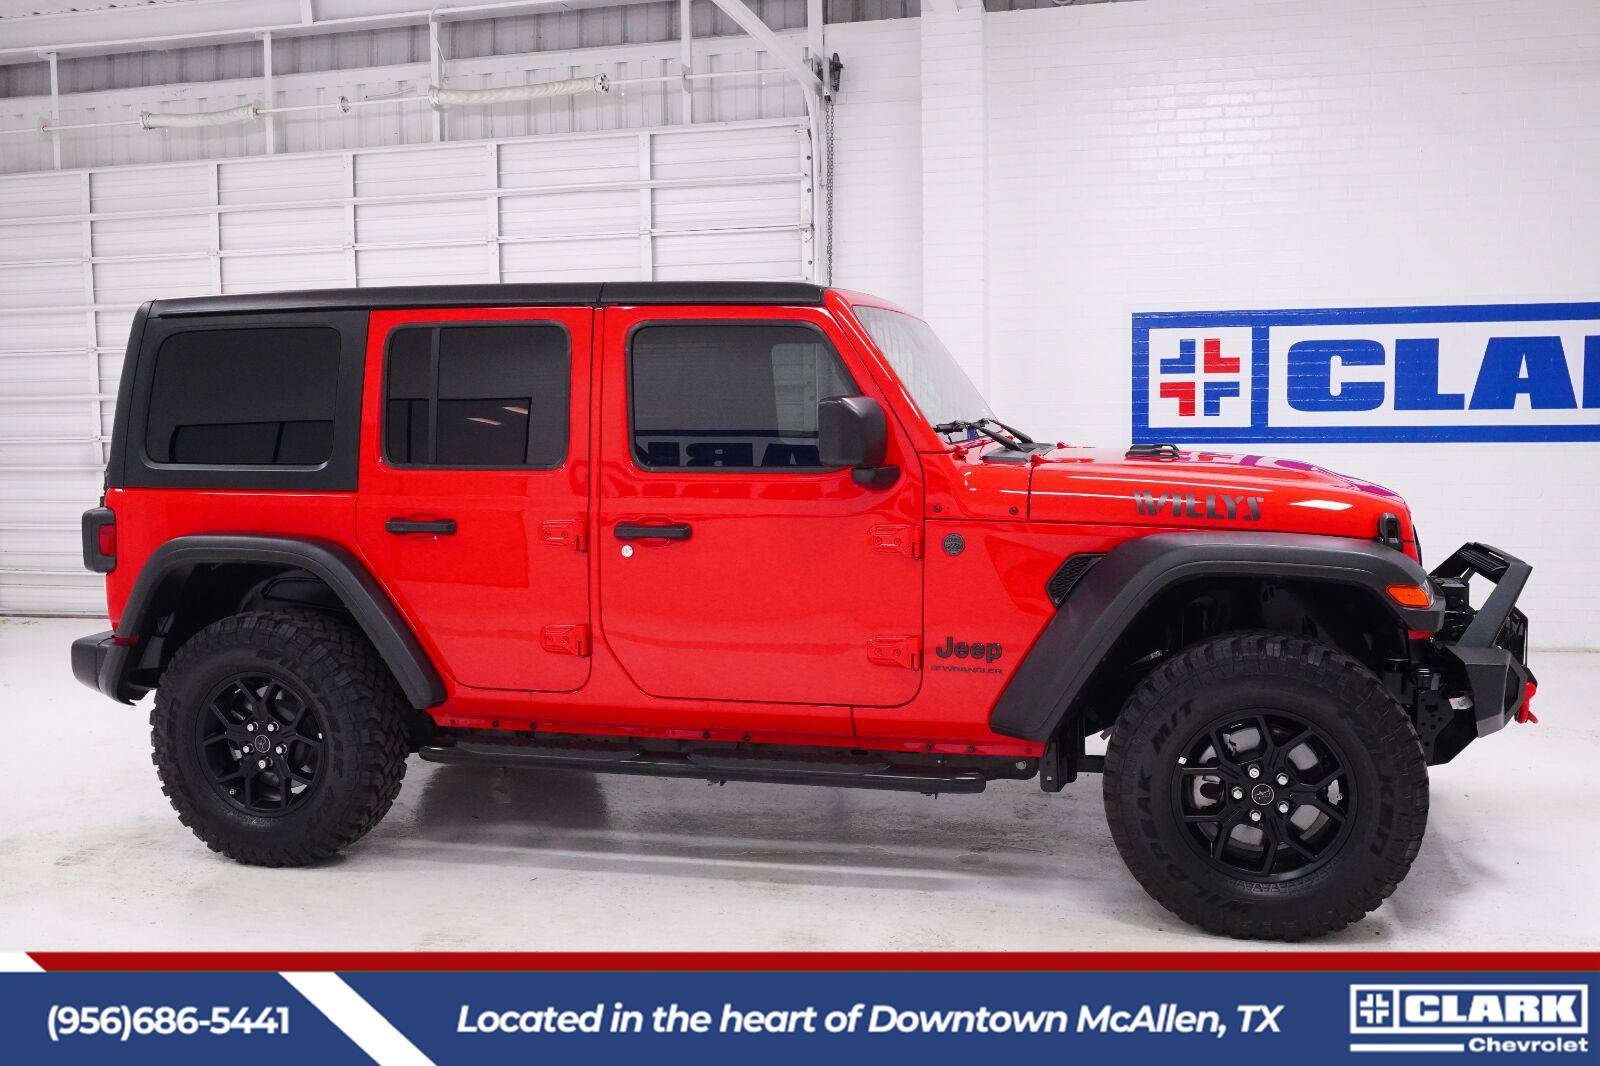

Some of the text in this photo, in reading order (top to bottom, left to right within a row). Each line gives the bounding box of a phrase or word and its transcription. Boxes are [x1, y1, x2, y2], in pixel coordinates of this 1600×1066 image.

[1287, 335, 1600, 412] CLA
[1133, 489, 1265, 522] WILLYS
[935, 636, 1003, 664] Jeep
[941, 665, 1003, 675] WRANGLER
